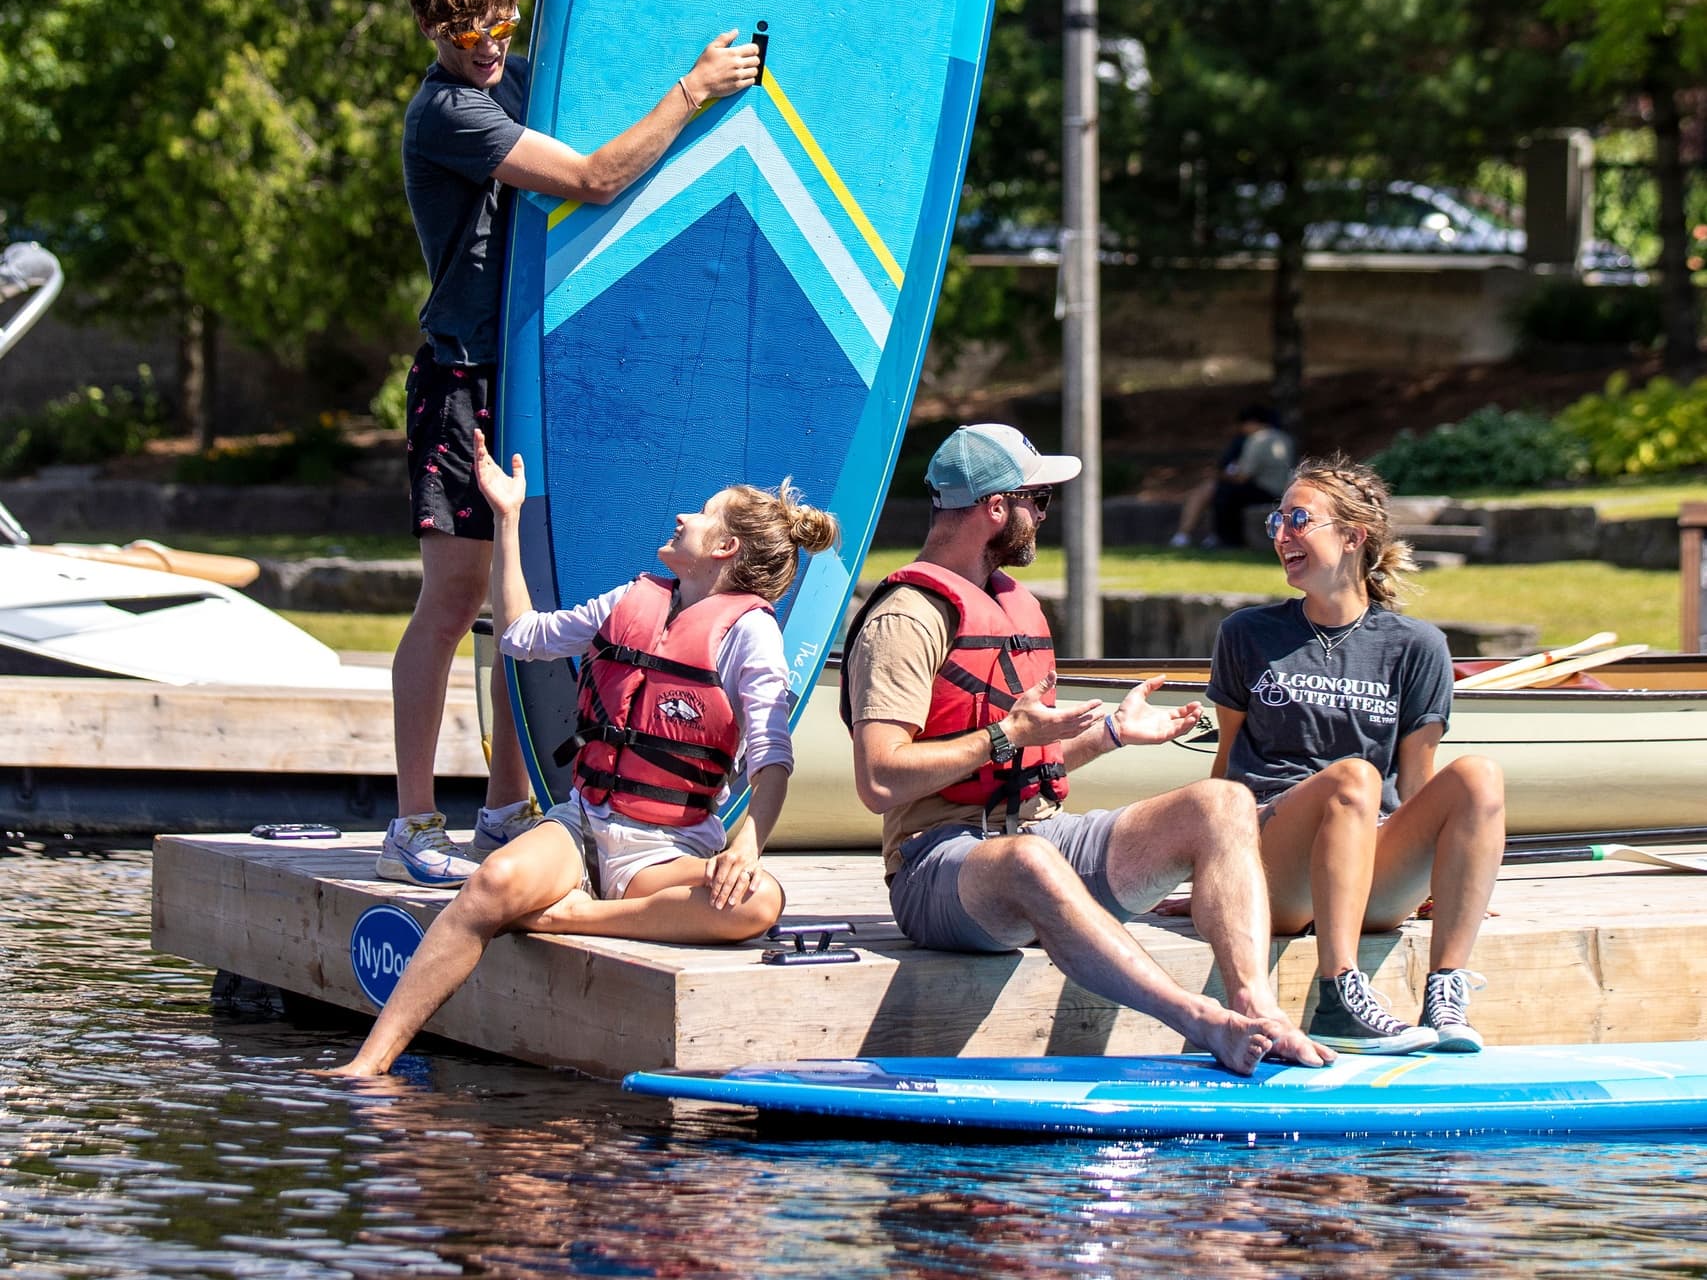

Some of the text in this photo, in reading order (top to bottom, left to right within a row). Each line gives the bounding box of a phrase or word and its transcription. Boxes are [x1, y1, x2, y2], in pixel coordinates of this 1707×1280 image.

[793, 640, 819, 668] The
[1250, 669, 1391, 698] ALGONQUIN
[1260, 684, 1398, 716] OUTFITTERS
